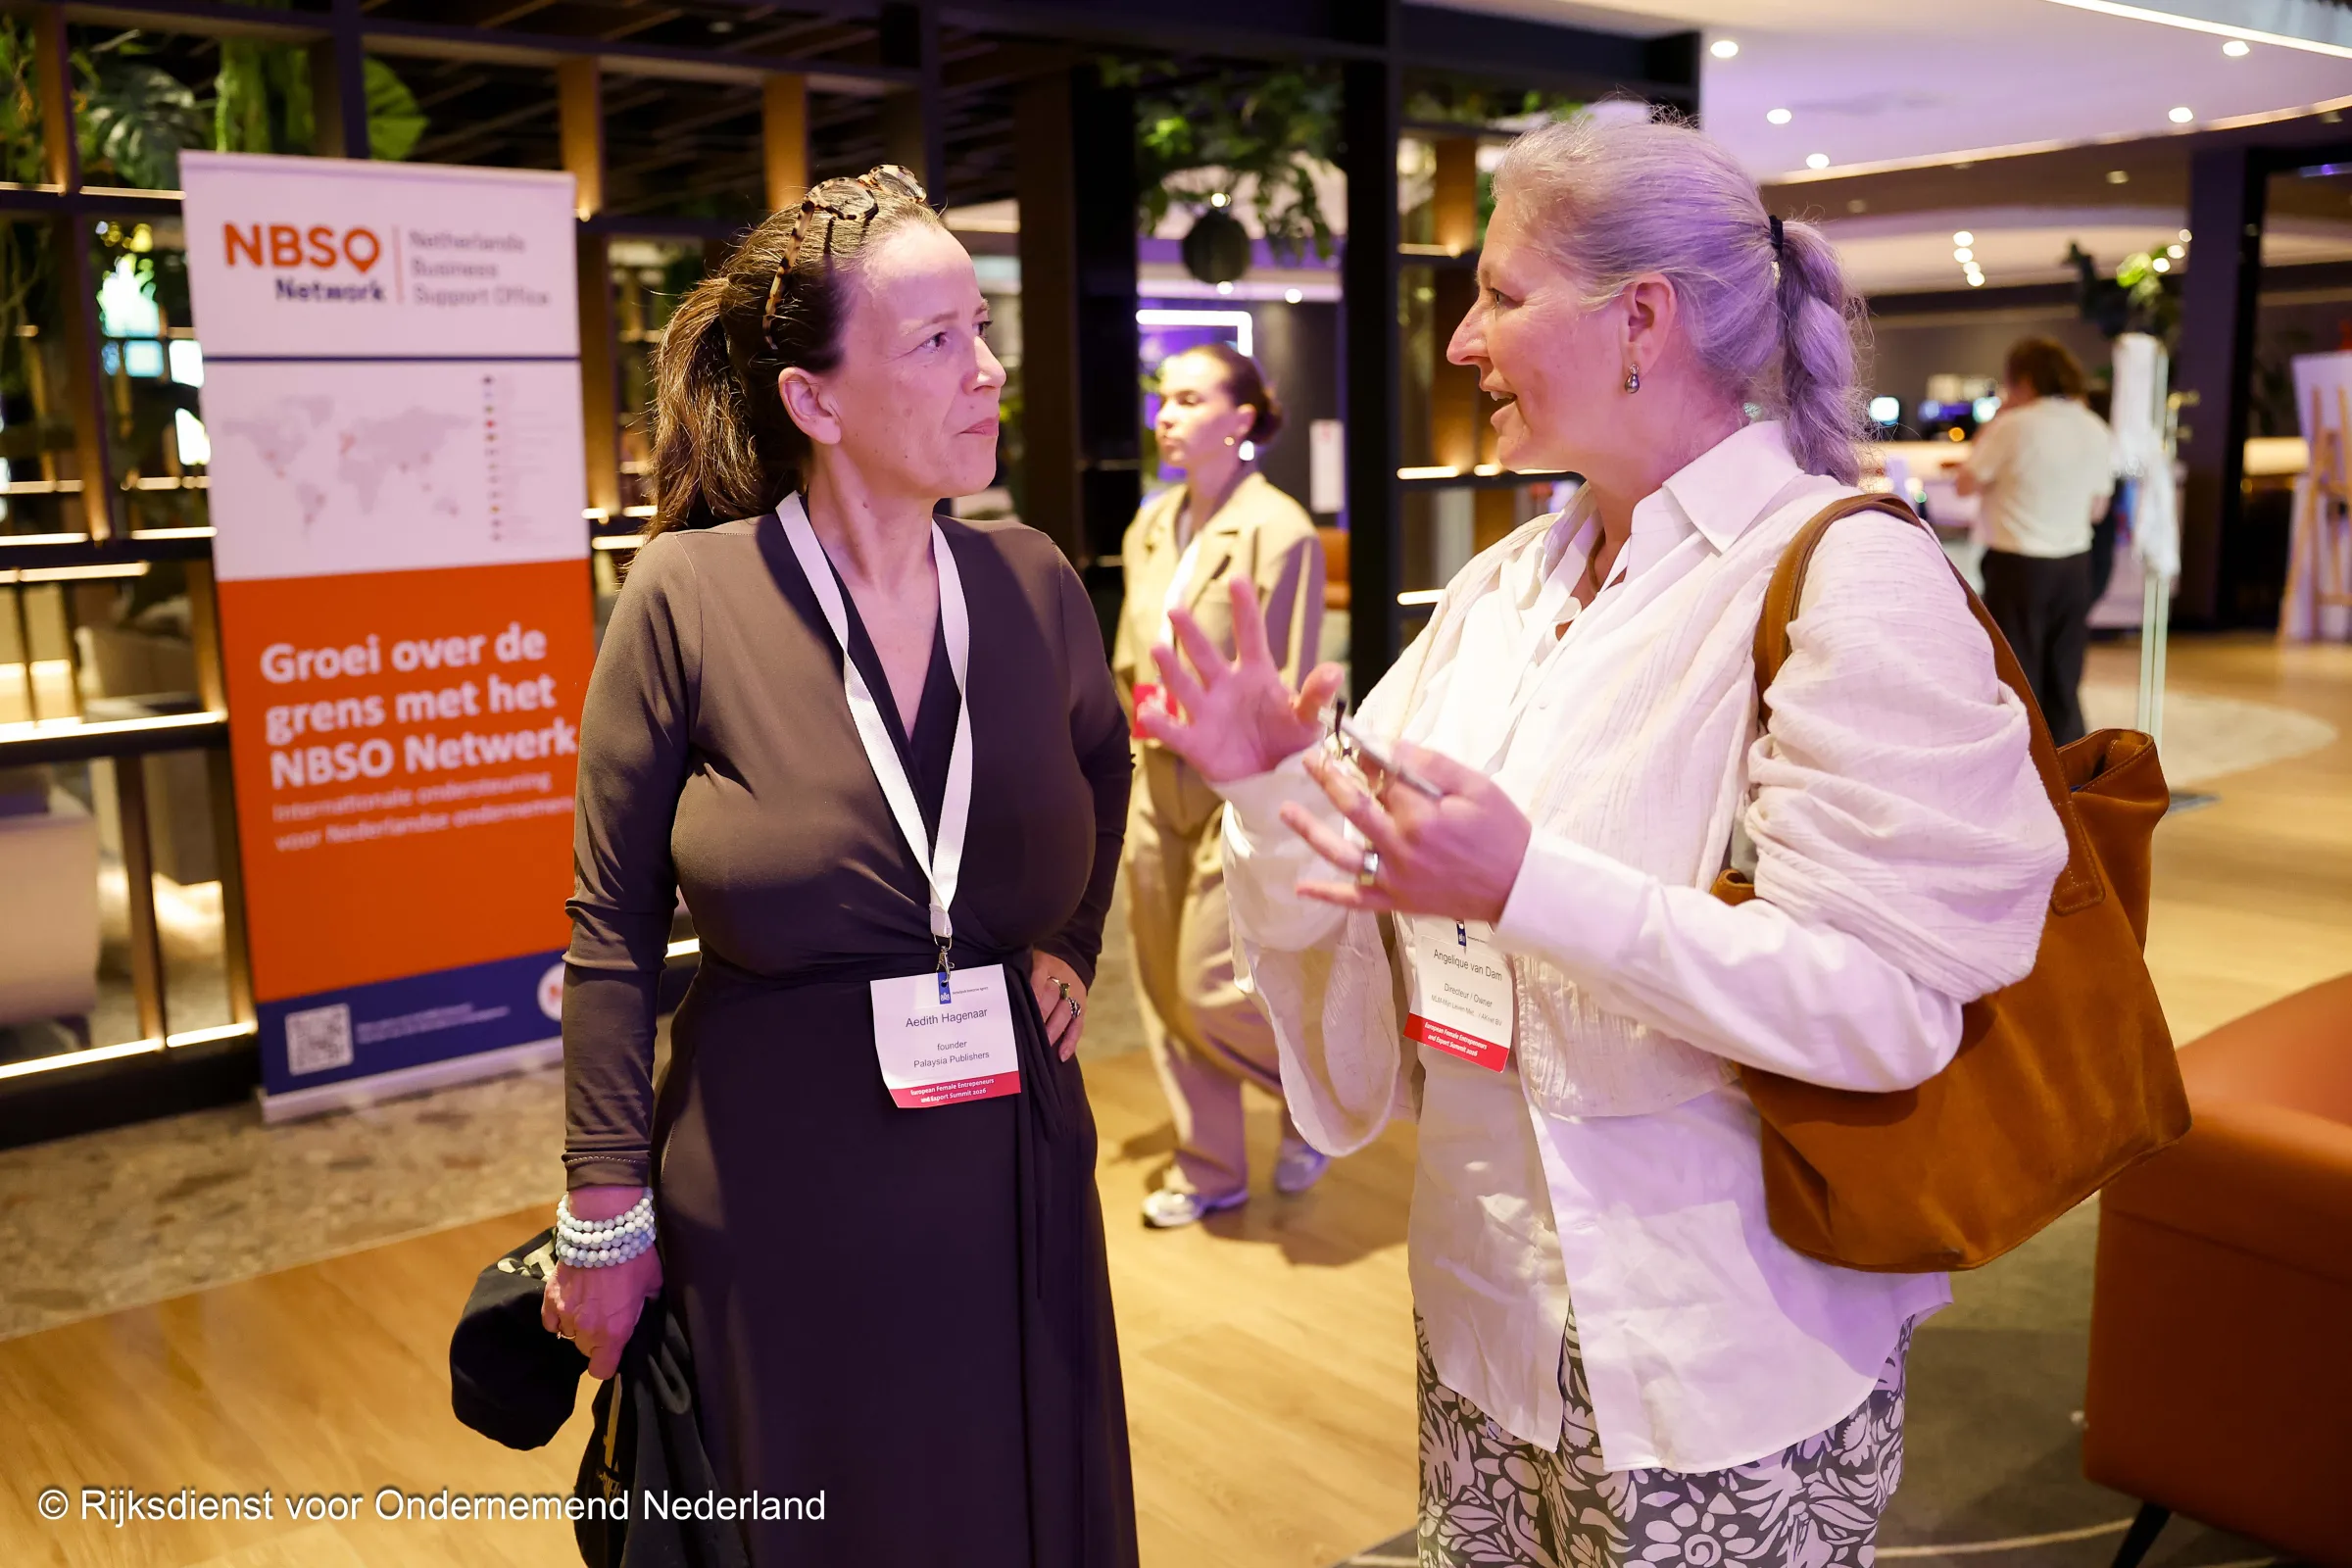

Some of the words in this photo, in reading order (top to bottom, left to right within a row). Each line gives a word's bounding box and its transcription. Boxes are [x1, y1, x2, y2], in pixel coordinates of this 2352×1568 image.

[222, 221, 380, 273] NBSO
[410, 231, 525, 253] Netherlands
[412, 259, 498, 277] Business
[275, 278, 385, 302] Network
[414, 286, 488, 307] Support
[261, 634, 381, 683] Groei
[392, 634, 486, 671] over
[495, 621, 547, 662] de
[266, 694, 384, 746] grens
[396, 681, 480, 722] met
[488, 673, 556, 712] het
[270, 738, 393, 789] NBSO
[404, 716, 576, 773] Netwerk
[1434, 949, 1469, 970] Angelique
[1470, 963, 1484, 975] van
[1486, 966, 1502, 981] Dam
[1445, 983, 1470, 1000] Directeur
[1473, 994, 1493, 1007] Owner
[906, 1015, 939, 1027] Aedith
[942, 1008, 988, 1024] Hagenaar
[937, 1041, 967, 1052] founder
[913, 1057, 948, 1068] Palaysia
[950, 1051, 990, 1063] Publishers
[910, 1086, 935, 1096] European
[930, 1094, 949, 1103] Export
[950, 1090, 972, 1100] Summit
